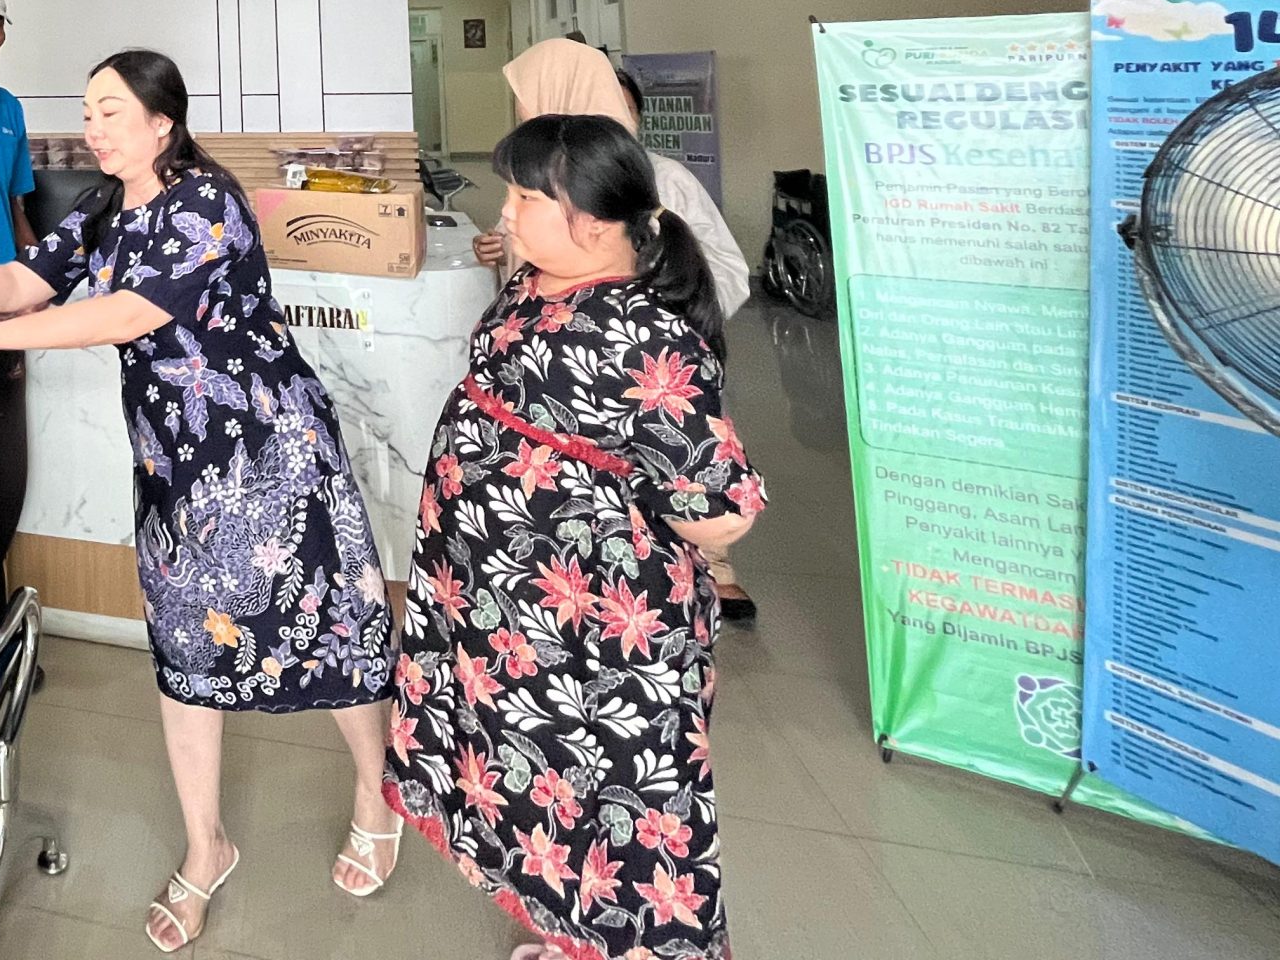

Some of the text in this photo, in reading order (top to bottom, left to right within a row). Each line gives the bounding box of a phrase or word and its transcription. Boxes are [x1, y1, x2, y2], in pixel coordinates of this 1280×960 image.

[1113, 62, 1201, 74] PENYAKIT
[1211, 61, 1265, 72] YANG
[838, 83, 966, 103] SESUAI
[639, 115, 712, 131] ENGADUAN
[897, 110, 1088, 130] REGULASI
[864, 142, 936, 165] BPJS
[1002, 186, 1042, 198] yang
[883, 199, 912, 209] IGD
[918, 199, 973, 212] Rumah
[979, 201, 1021, 214] Sakit
[852, 213, 925, 228] Peraturan
[930, 217, 1002, 231] Presiden
[1006, 220, 1036, 232] No.
[1041, 222, 1061, 233] 82
[876, 231, 916, 244] harus
[920, 236, 1000, 249] memenuhi
[1004, 239, 1048, 252] salah
[960, 255, 1025, 269] dibawah
[888, 311, 916, 323] dan
[974, 318, 1009, 332] Lain
[879, 326, 938, 344] Adanya
[941, 332, 1027, 352] Gangguan
[1032, 340, 1075, 357] pada
[882, 365, 942, 382] Adanya
[1013, 359, 1044, 374] dan
[884, 383, 943, 401] Adanya
[948, 391, 1035, 413] Gangguan
[886, 402, 927, 418] Pada
[931, 409, 982, 425] Kasus
[870, 420, 1005, 448] Tindakan Segera
[875, 465, 946, 489] Dengan
[952, 478, 1040, 505] demikian
[884, 490, 977, 520] Pinggang,
[984, 507, 1040, 529] Asam
[905, 516, 986, 541] Penyakit
[992, 531, 1064, 558] lainnya
[891, 559, 960, 586] TIDAK
[952, 548, 1077, 584] Mengancam
[887, 609, 936, 634] Yang
[942, 621, 1018, 651] Dijamin
